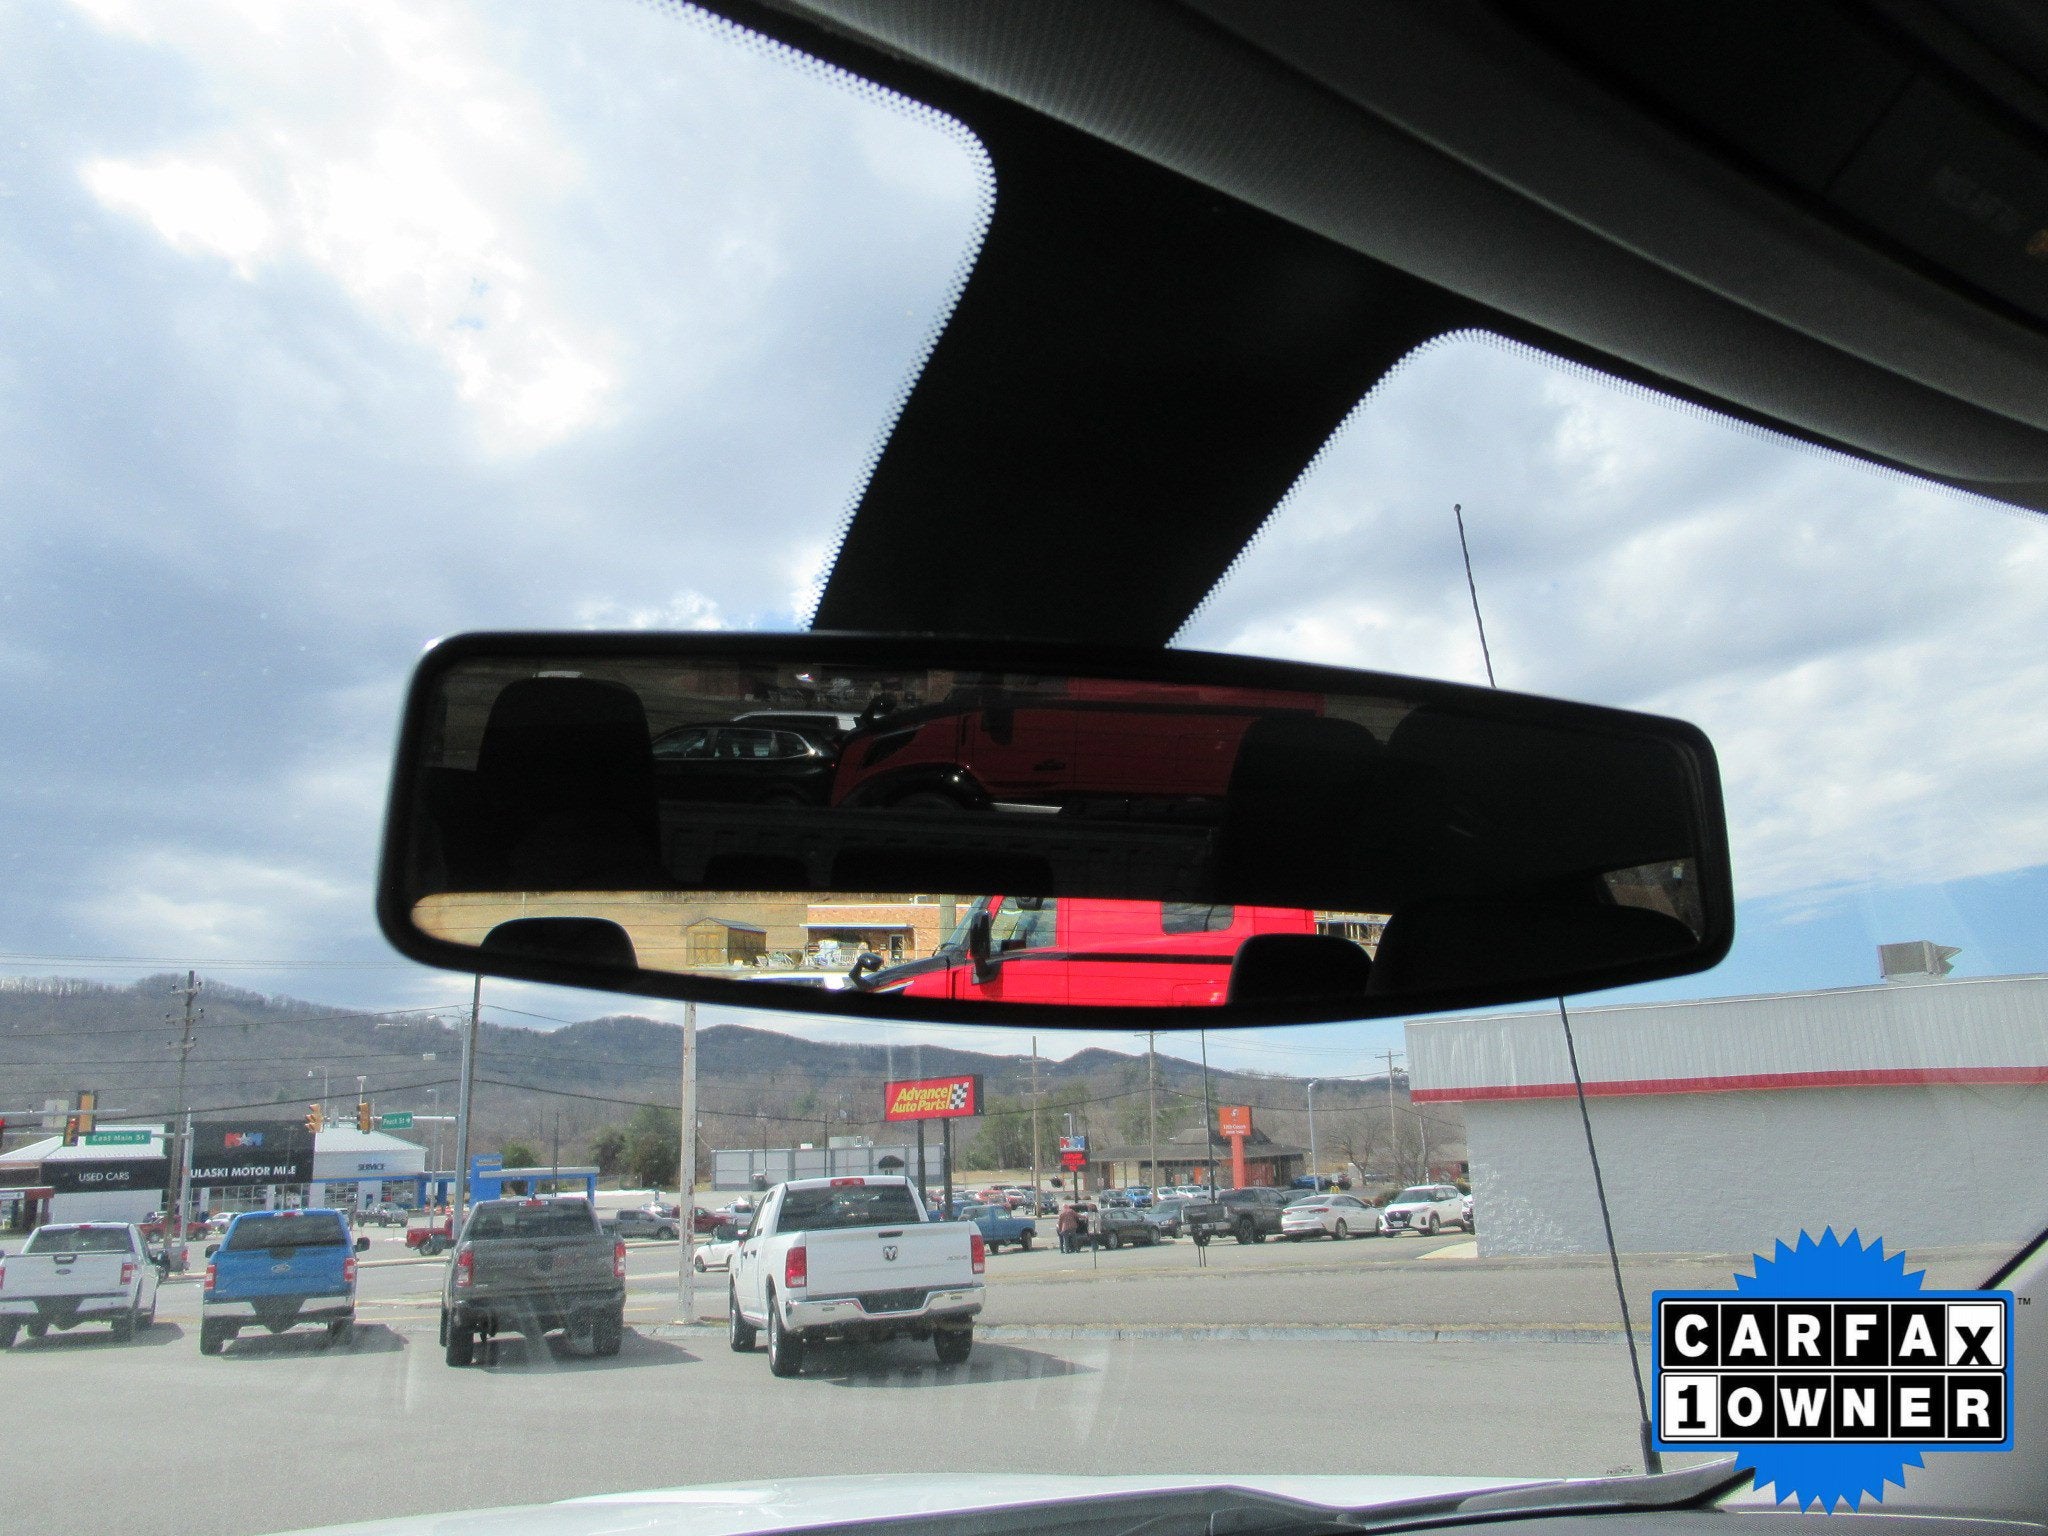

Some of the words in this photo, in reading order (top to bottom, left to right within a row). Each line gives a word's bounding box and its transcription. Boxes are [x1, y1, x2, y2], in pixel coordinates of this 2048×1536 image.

[897, 1086, 949, 1101] Advance
[890, 1101, 917, 1113] Auto
[917, 1099, 946, 1111] Parts
[190, 1167, 229, 1178] ULASKI
[231, 1166, 271, 1177] MOTOR
[358, 1163, 386, 1171] SERVICE
[79, 1172, 104, 1182] USED
[105, 1171, 130, 1181] CARS
